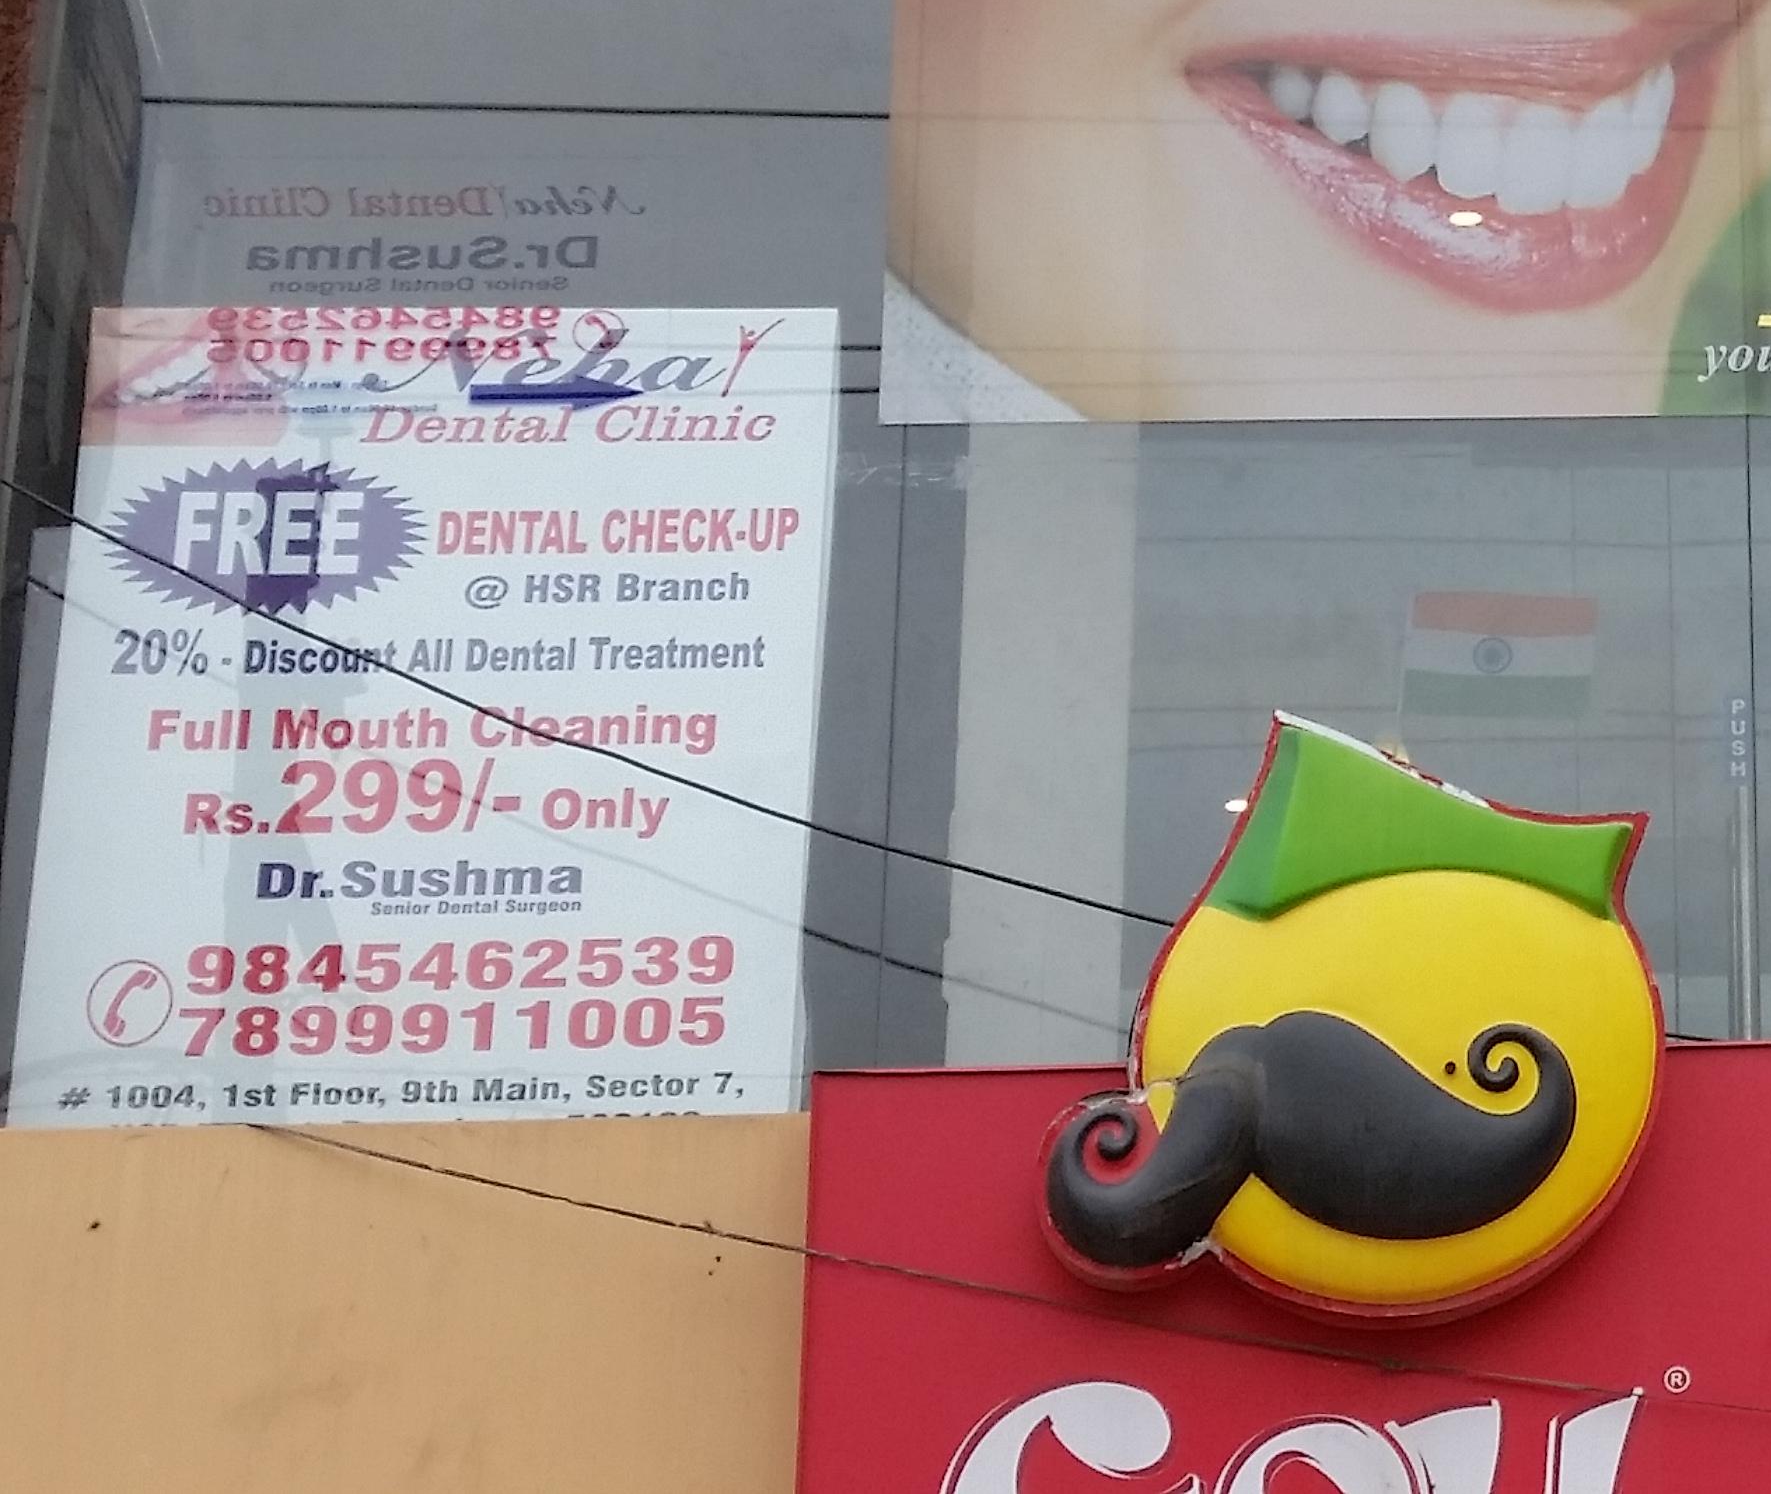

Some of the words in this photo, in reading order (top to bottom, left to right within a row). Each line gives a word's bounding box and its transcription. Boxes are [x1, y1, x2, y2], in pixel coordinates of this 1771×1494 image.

[363, 326, 726, 394] Neha
[359, 402, 570, 444] Dental
[596, 402, 776, 444] Clinic
[172, 490, 365, 577] FREE
[437, 508, 587, 555] DENTAL
[600, 506, 801, 553] CHECK-UP
[465, 574, 510, 609] @
[524, 573, 601, 605] HSR
[616, 572, 750, 604] Branch
[111, 628, 208, 676] 20%
[244, 639, 396, 675] Discount
[407, 638, 454, 673] All
[464, 637, 576, 673] Dental
[589, 637, 766, 672] Treatment
[146, 708, 252, 752] Full
[272, 707, 448, 751] Mouth
[469, 705, 718, 755] Cleaning
[1730, 697, 1746, 777] PUSH
[542, 787, 670, 840] Only
[255, 859, 583, 900] Dr.Sushma
[370, 900, 431, 916] Senior
[437, 899, 498, 916] Dental
[505, 897, 582, 917] Surgeon
[186, 934, 735, 997] 9845462539
[178, 995, 725, 1057] 7899911005
[106, 1083, 206, 1110] 1004,
[223, 1081, 275, 1107] 1st
[290, 1079, 387, 1109] Floor,
[401, 1076, 457, 1103] 9th
[472, 1073, 571, 1104] Main,
[585, 1071, 700, 1098] Sector
[713, 1069, 744, 1099] 7,
